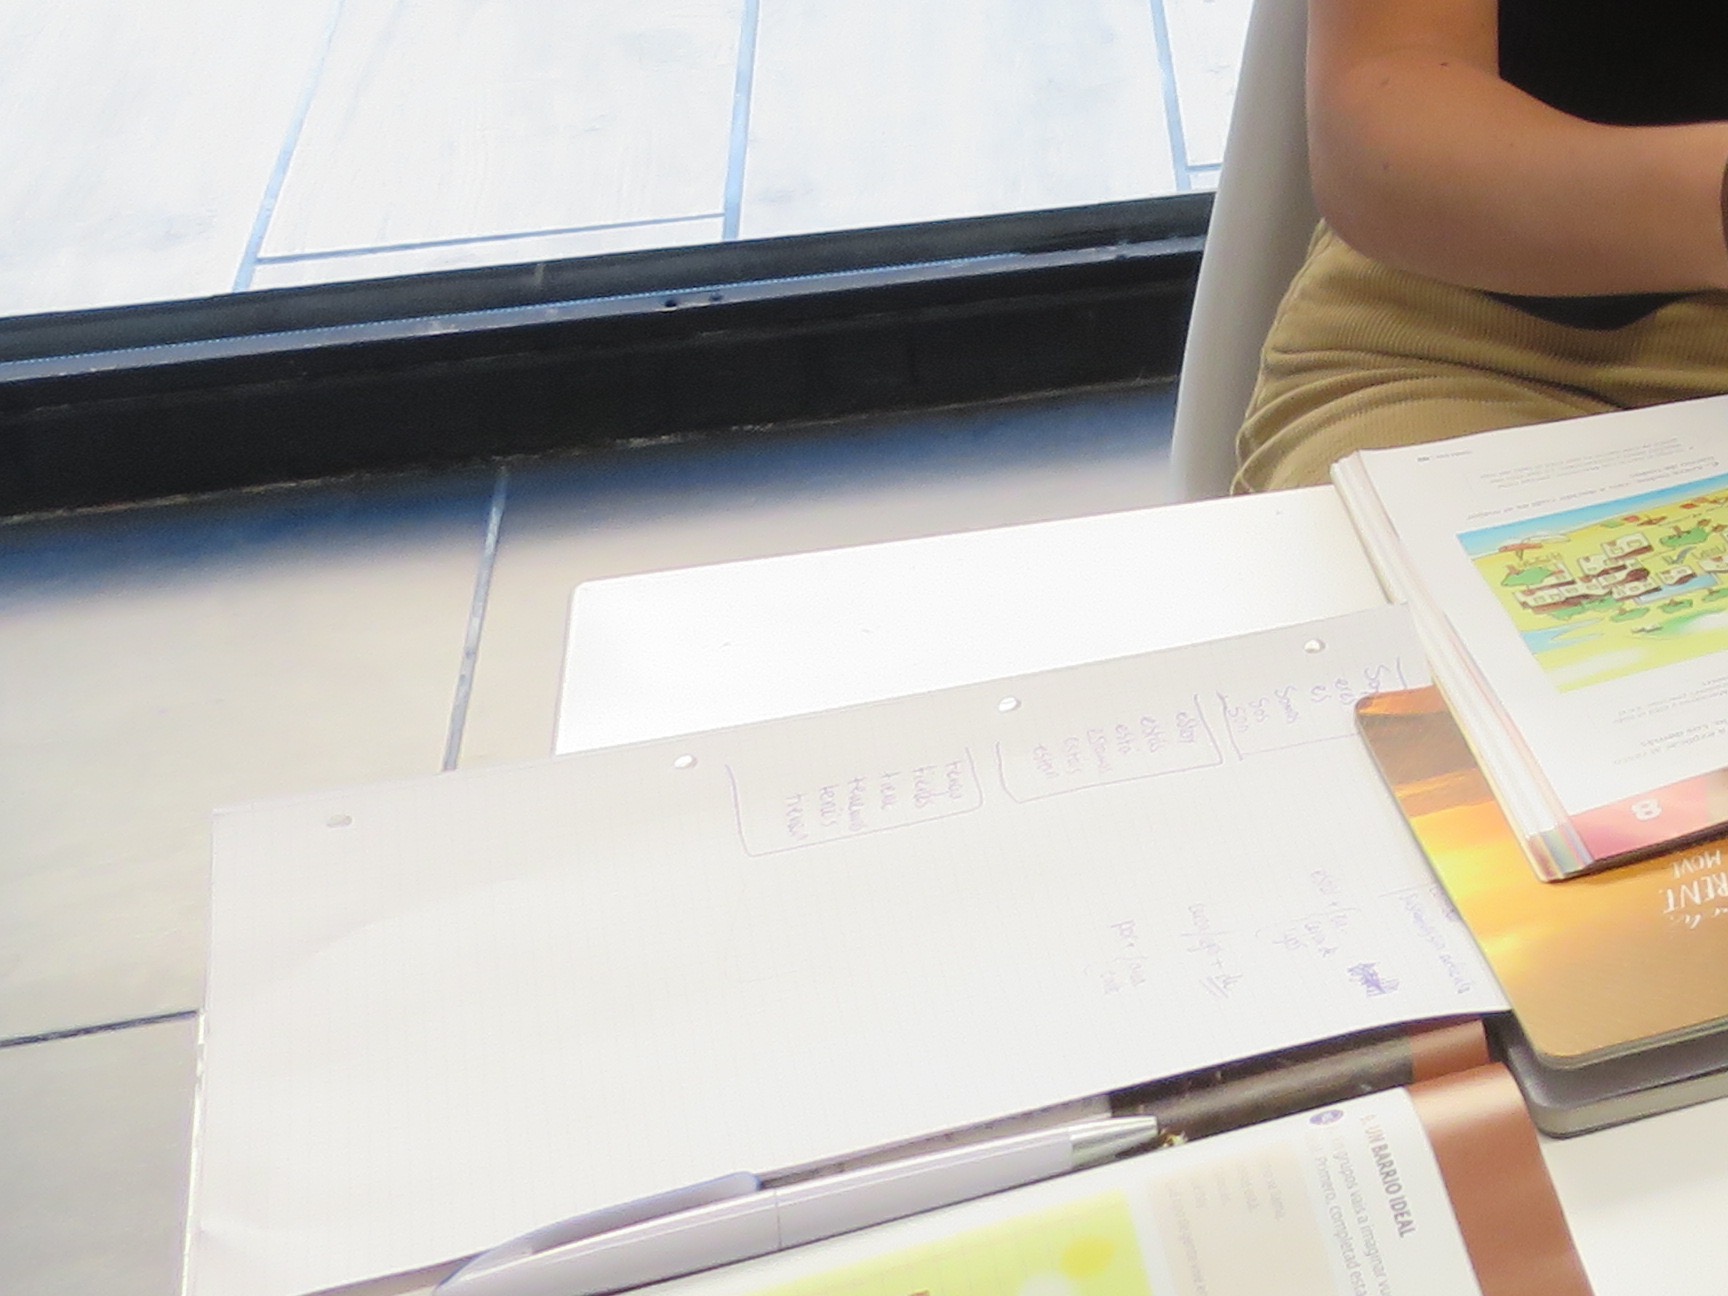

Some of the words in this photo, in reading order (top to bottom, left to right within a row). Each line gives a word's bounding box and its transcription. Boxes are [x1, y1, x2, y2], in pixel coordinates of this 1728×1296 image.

[1628, 795, 1664, 823] 8
[1329, 1148, 1360, 1192] grupos
[1369, 1141, 1403, 1197] BARRIO
[1387, 1193, 1418, 1240] IDEAL
[1347, 1189, 1367, 1215] vais
[1325, 1202, 1362, 1273] completad
[1353, 1222, 1389, 1282] imaginar
